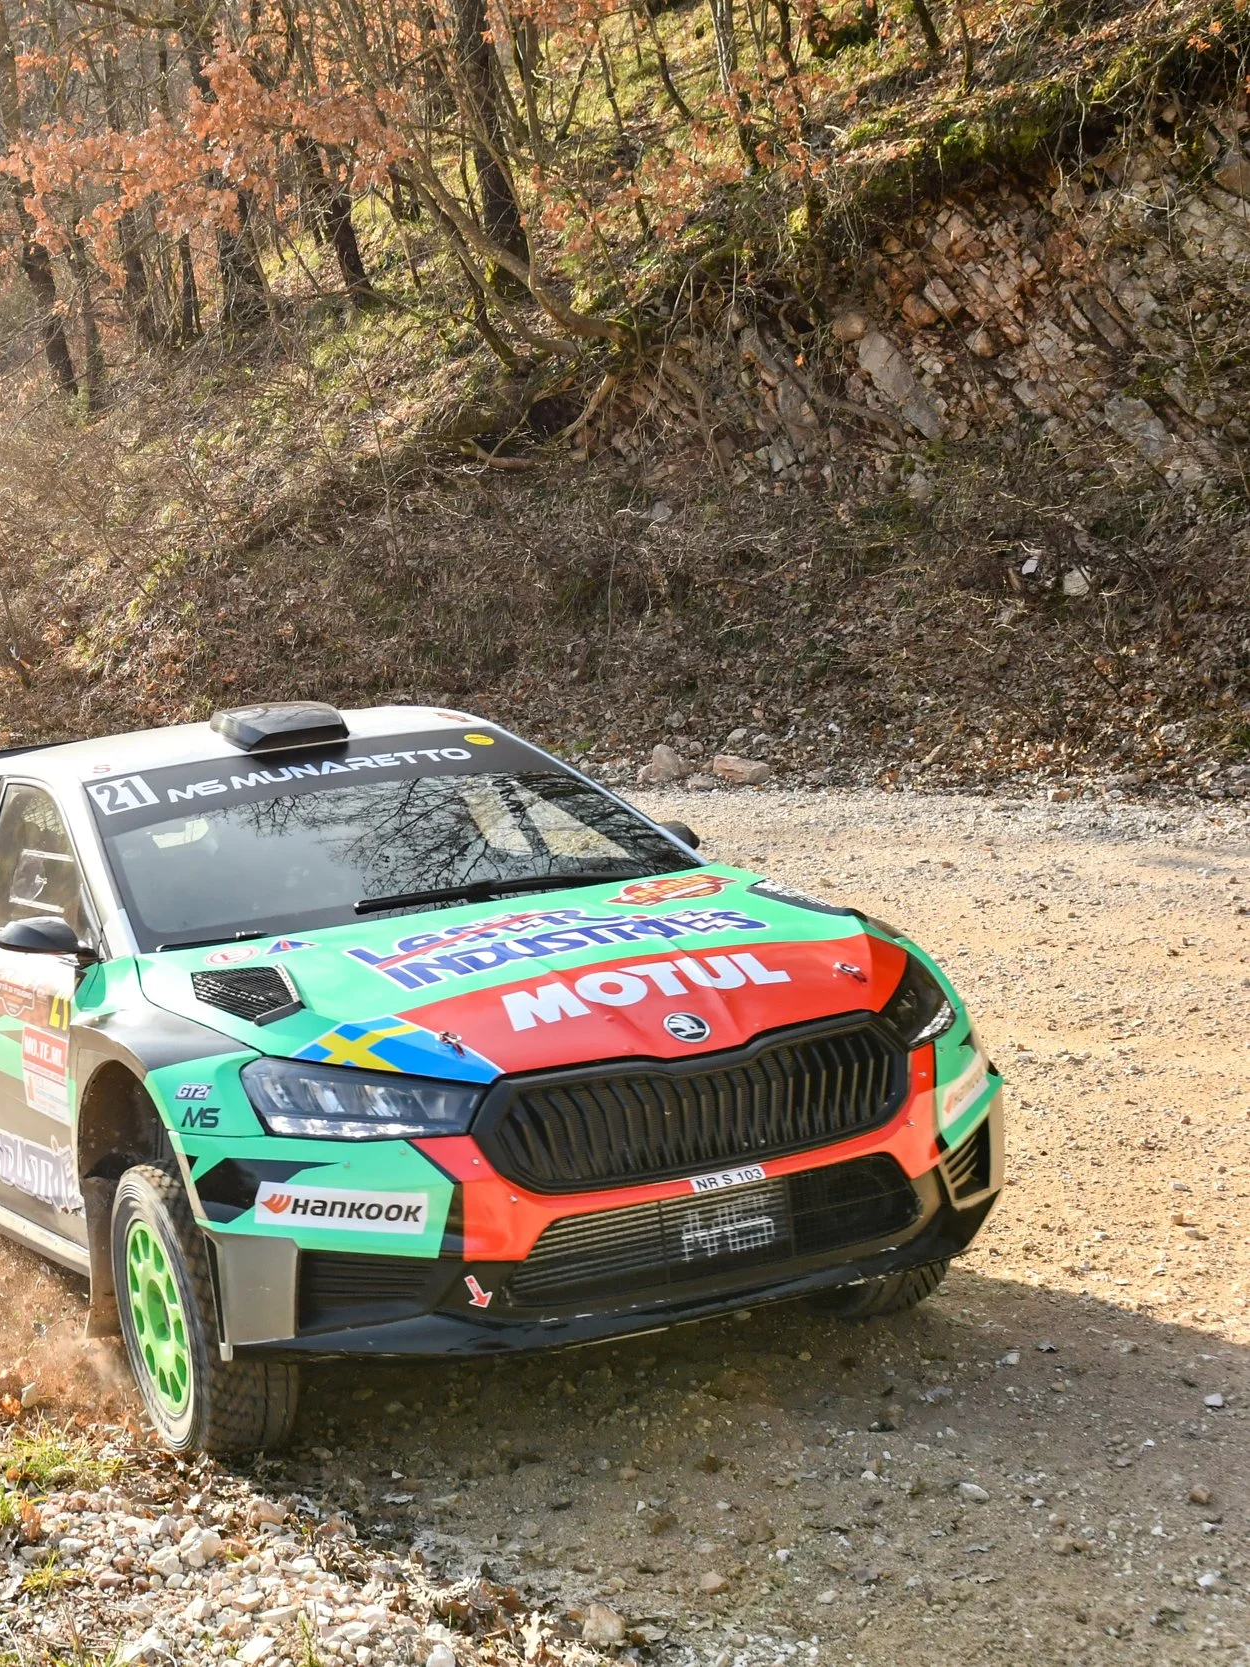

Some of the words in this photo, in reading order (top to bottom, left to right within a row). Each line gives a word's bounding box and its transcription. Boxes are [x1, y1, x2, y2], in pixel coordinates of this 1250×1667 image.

[167, 779, 228, 804] MS
[230, 748, 472, 790] MUNARETTO
[96, 779, 146, 812] 21
[501, 953, 792, 1032] MOTUL
[181, 1106, 221, 1128] MS
[696, 1176, 719, 1191] NR
[721, 1174, 734, 1185] S
[737, 1168, 763, 1182] 103
